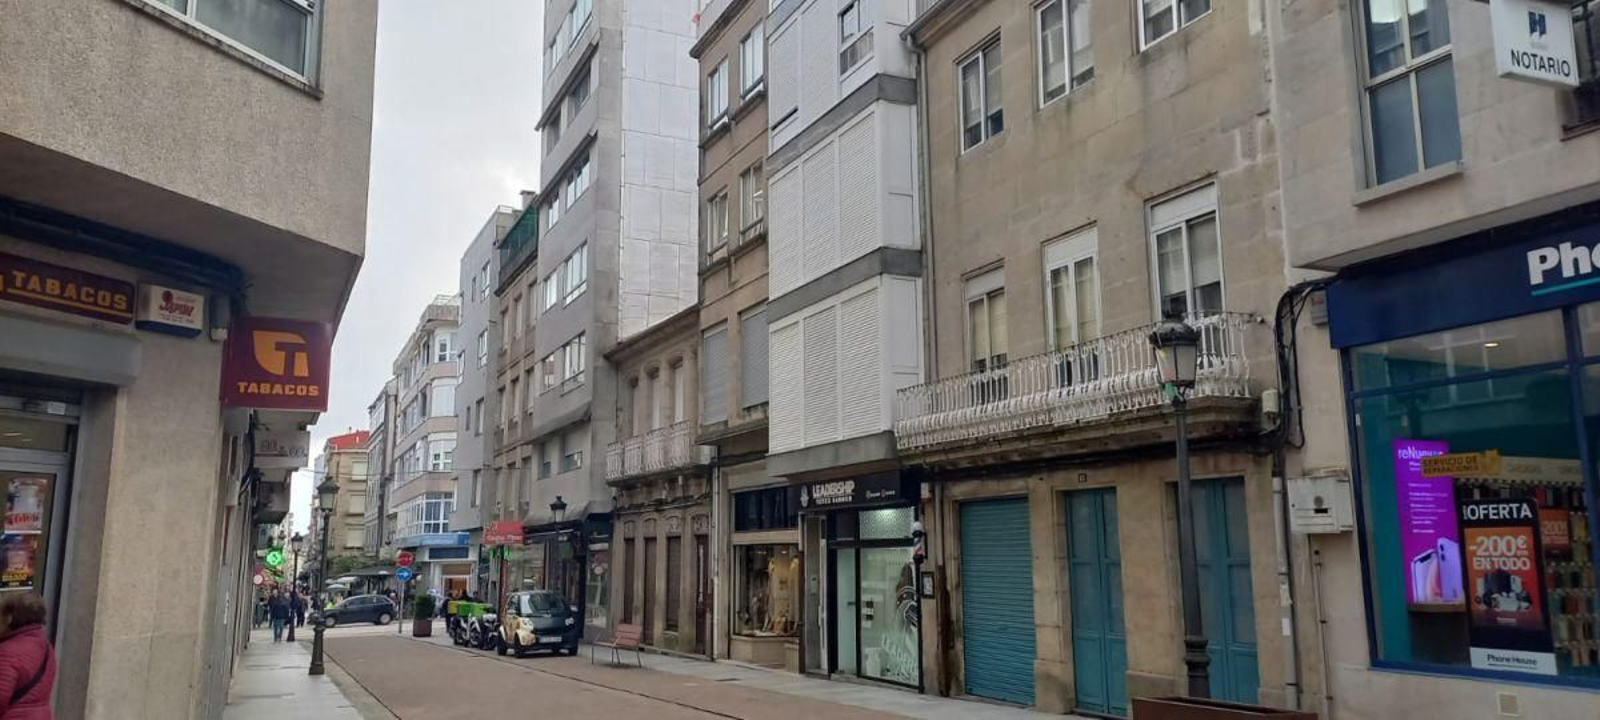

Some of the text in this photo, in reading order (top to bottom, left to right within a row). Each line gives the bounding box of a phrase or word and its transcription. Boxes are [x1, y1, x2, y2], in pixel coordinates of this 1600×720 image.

[1511, 48, 1571, 77] NOTARIO
[1527, 242, 1600, 285] Ph
[12, 269, 128, 310] TABACOS
[237, 382, 320, 396] TABACOS
[1467, 503, 1533, 520] OFERTA
[1468, 535, 1528, 556] -200€
[1473, 557, 1531, 570] EN TODO
[1487, 653, 1538, 665] Phone House
